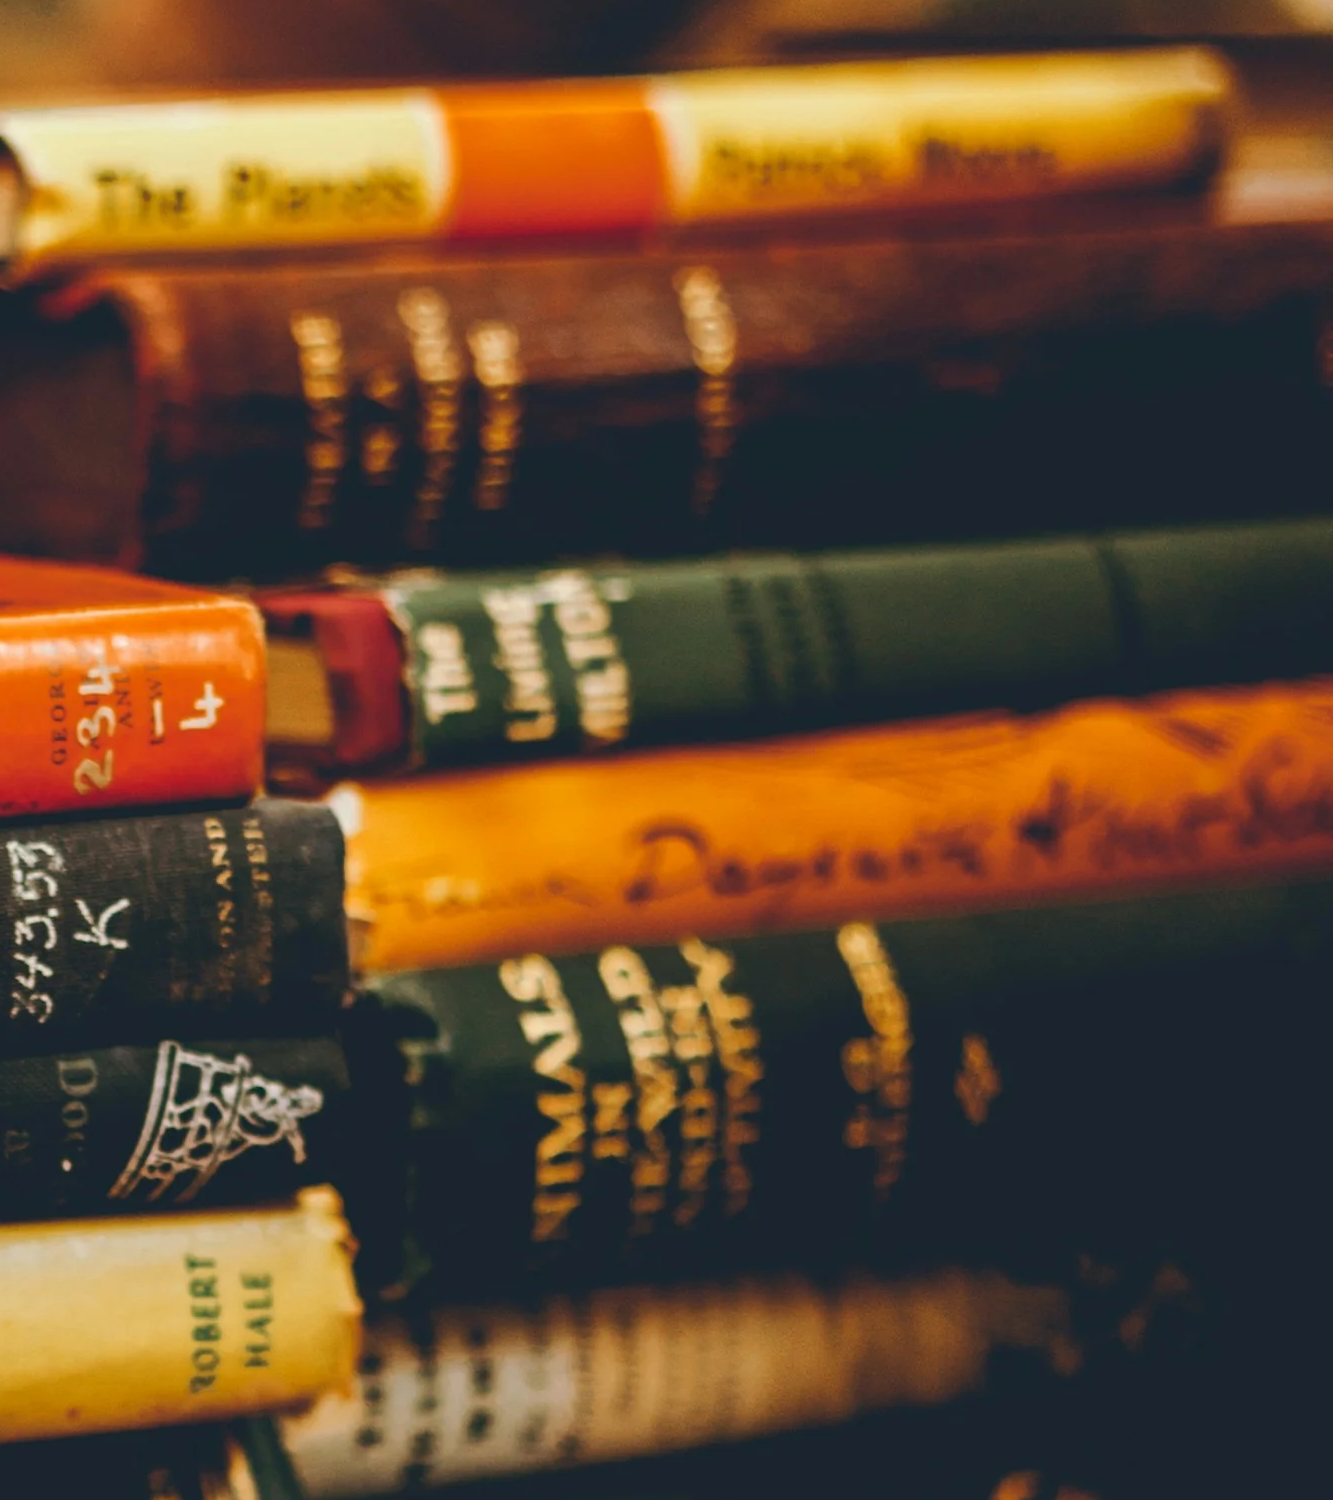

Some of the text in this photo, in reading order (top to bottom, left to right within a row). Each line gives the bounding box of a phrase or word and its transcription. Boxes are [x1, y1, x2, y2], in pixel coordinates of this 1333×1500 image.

[202, 816, 234, 892] AND
[72, 897, 131, 950] K
[186, 1251, 219, 1394] ROBERT
[241, 1272, 275, 1369] HALE
